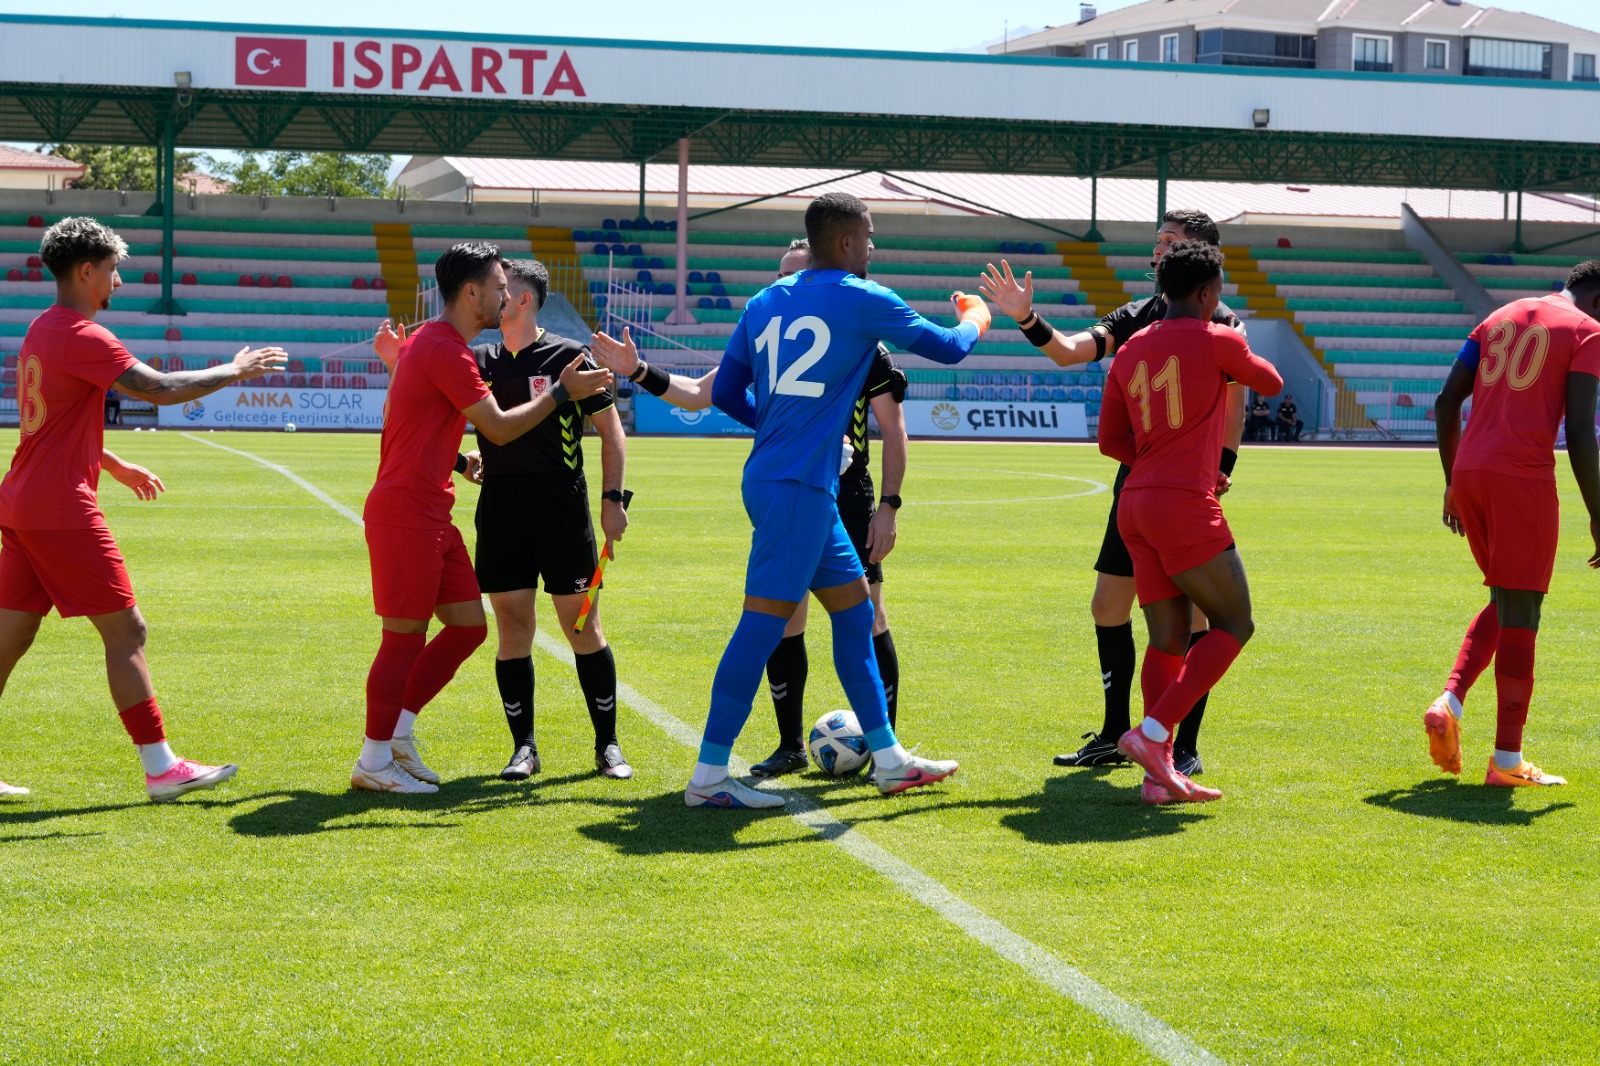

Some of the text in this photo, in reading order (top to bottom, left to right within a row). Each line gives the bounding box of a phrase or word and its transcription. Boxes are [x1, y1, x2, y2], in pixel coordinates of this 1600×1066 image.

[332, 41, 587, 97] ISPARTA
[755, 315, 831, 398] 12
[1480, 319, 1550, 391] 30
[214, 410, 384, 425] Geleceğe Enerjiniz Kalsın
[236, 391, 362, 409] ANKA SOLAR
[967, 404, 1059, 430] ÇETİNLİ
[1127, 355, 1184, 433] 11
